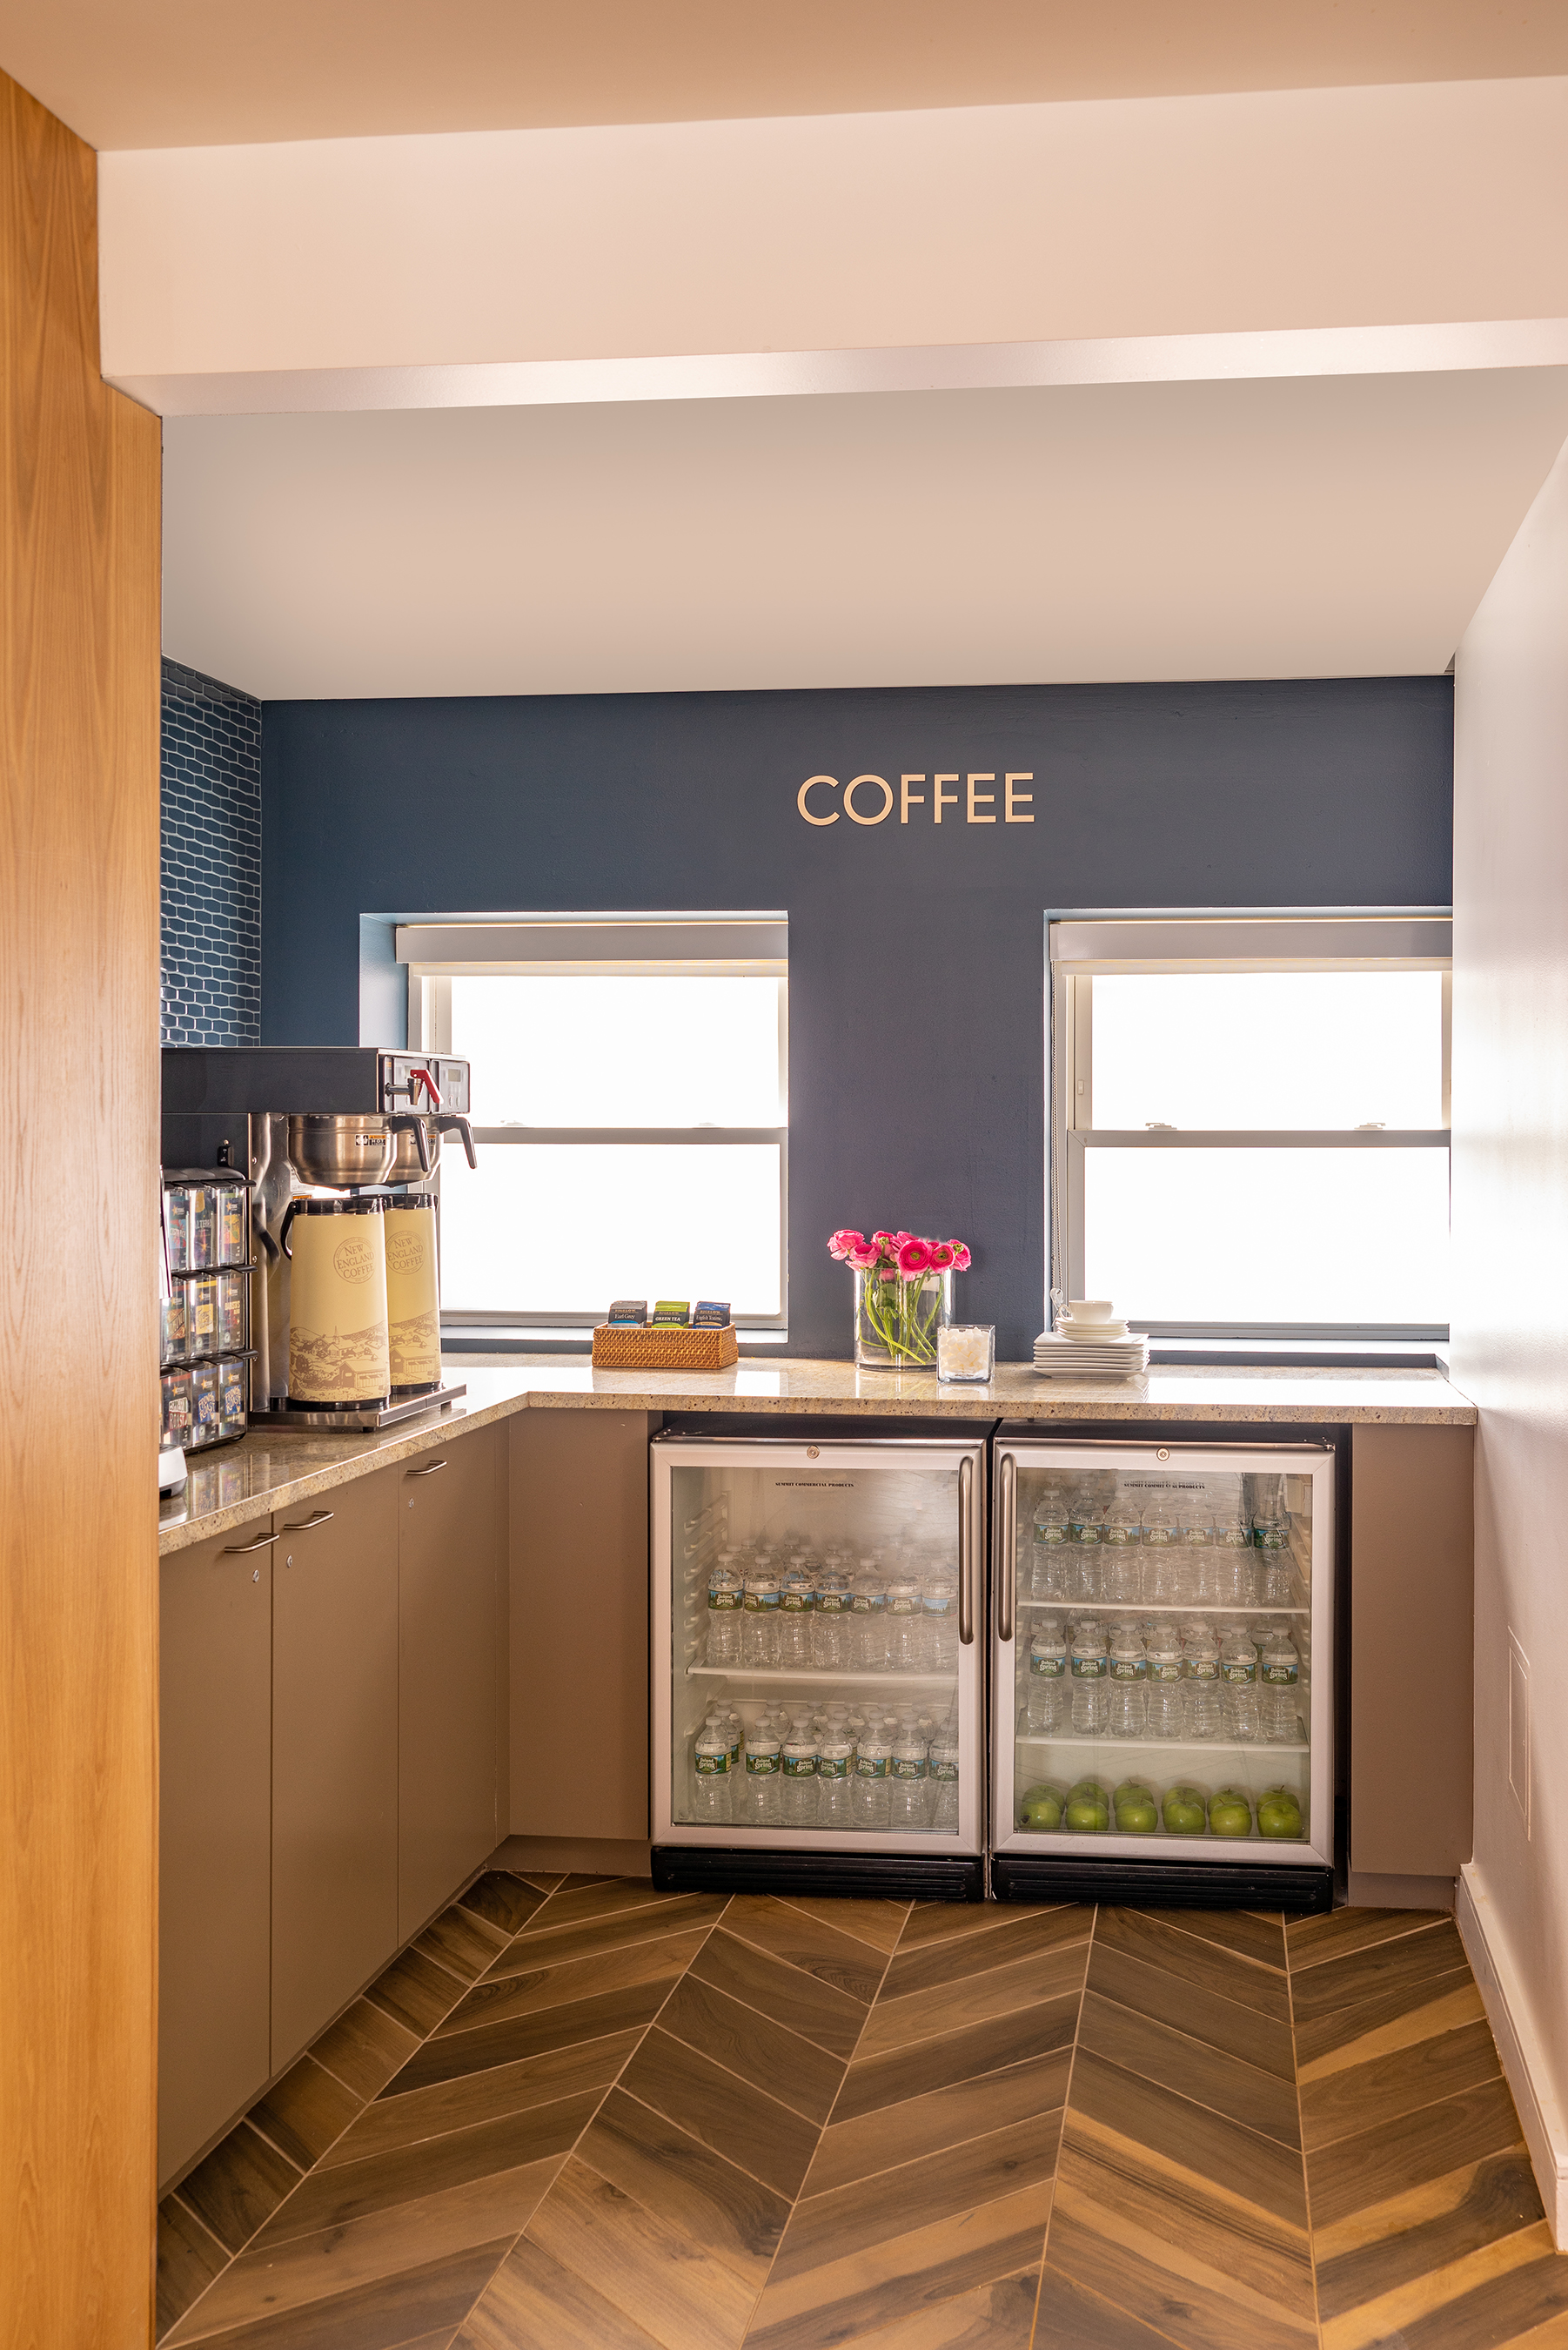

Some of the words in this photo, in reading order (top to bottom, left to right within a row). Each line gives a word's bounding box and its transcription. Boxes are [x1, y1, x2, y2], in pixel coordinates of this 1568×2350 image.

[797, 772, 1035, 826] COFFEE
[393, 1237, 412, 1249] NEW
[344, 1244, 364, 1256] NEW
[387, 1245, 423, 1261] ENGLAND
[337, 1252, 375, 1269] ENGLAND
[392, 1255, 423, 1270] COFFEE
[343, 1263, 374, 1279] COFFEE
[1116, 1668, 1134, 1676] Spring
[821, 1765, 835, 1774] Spring
[858, 1764, 874, 1773] Spring
